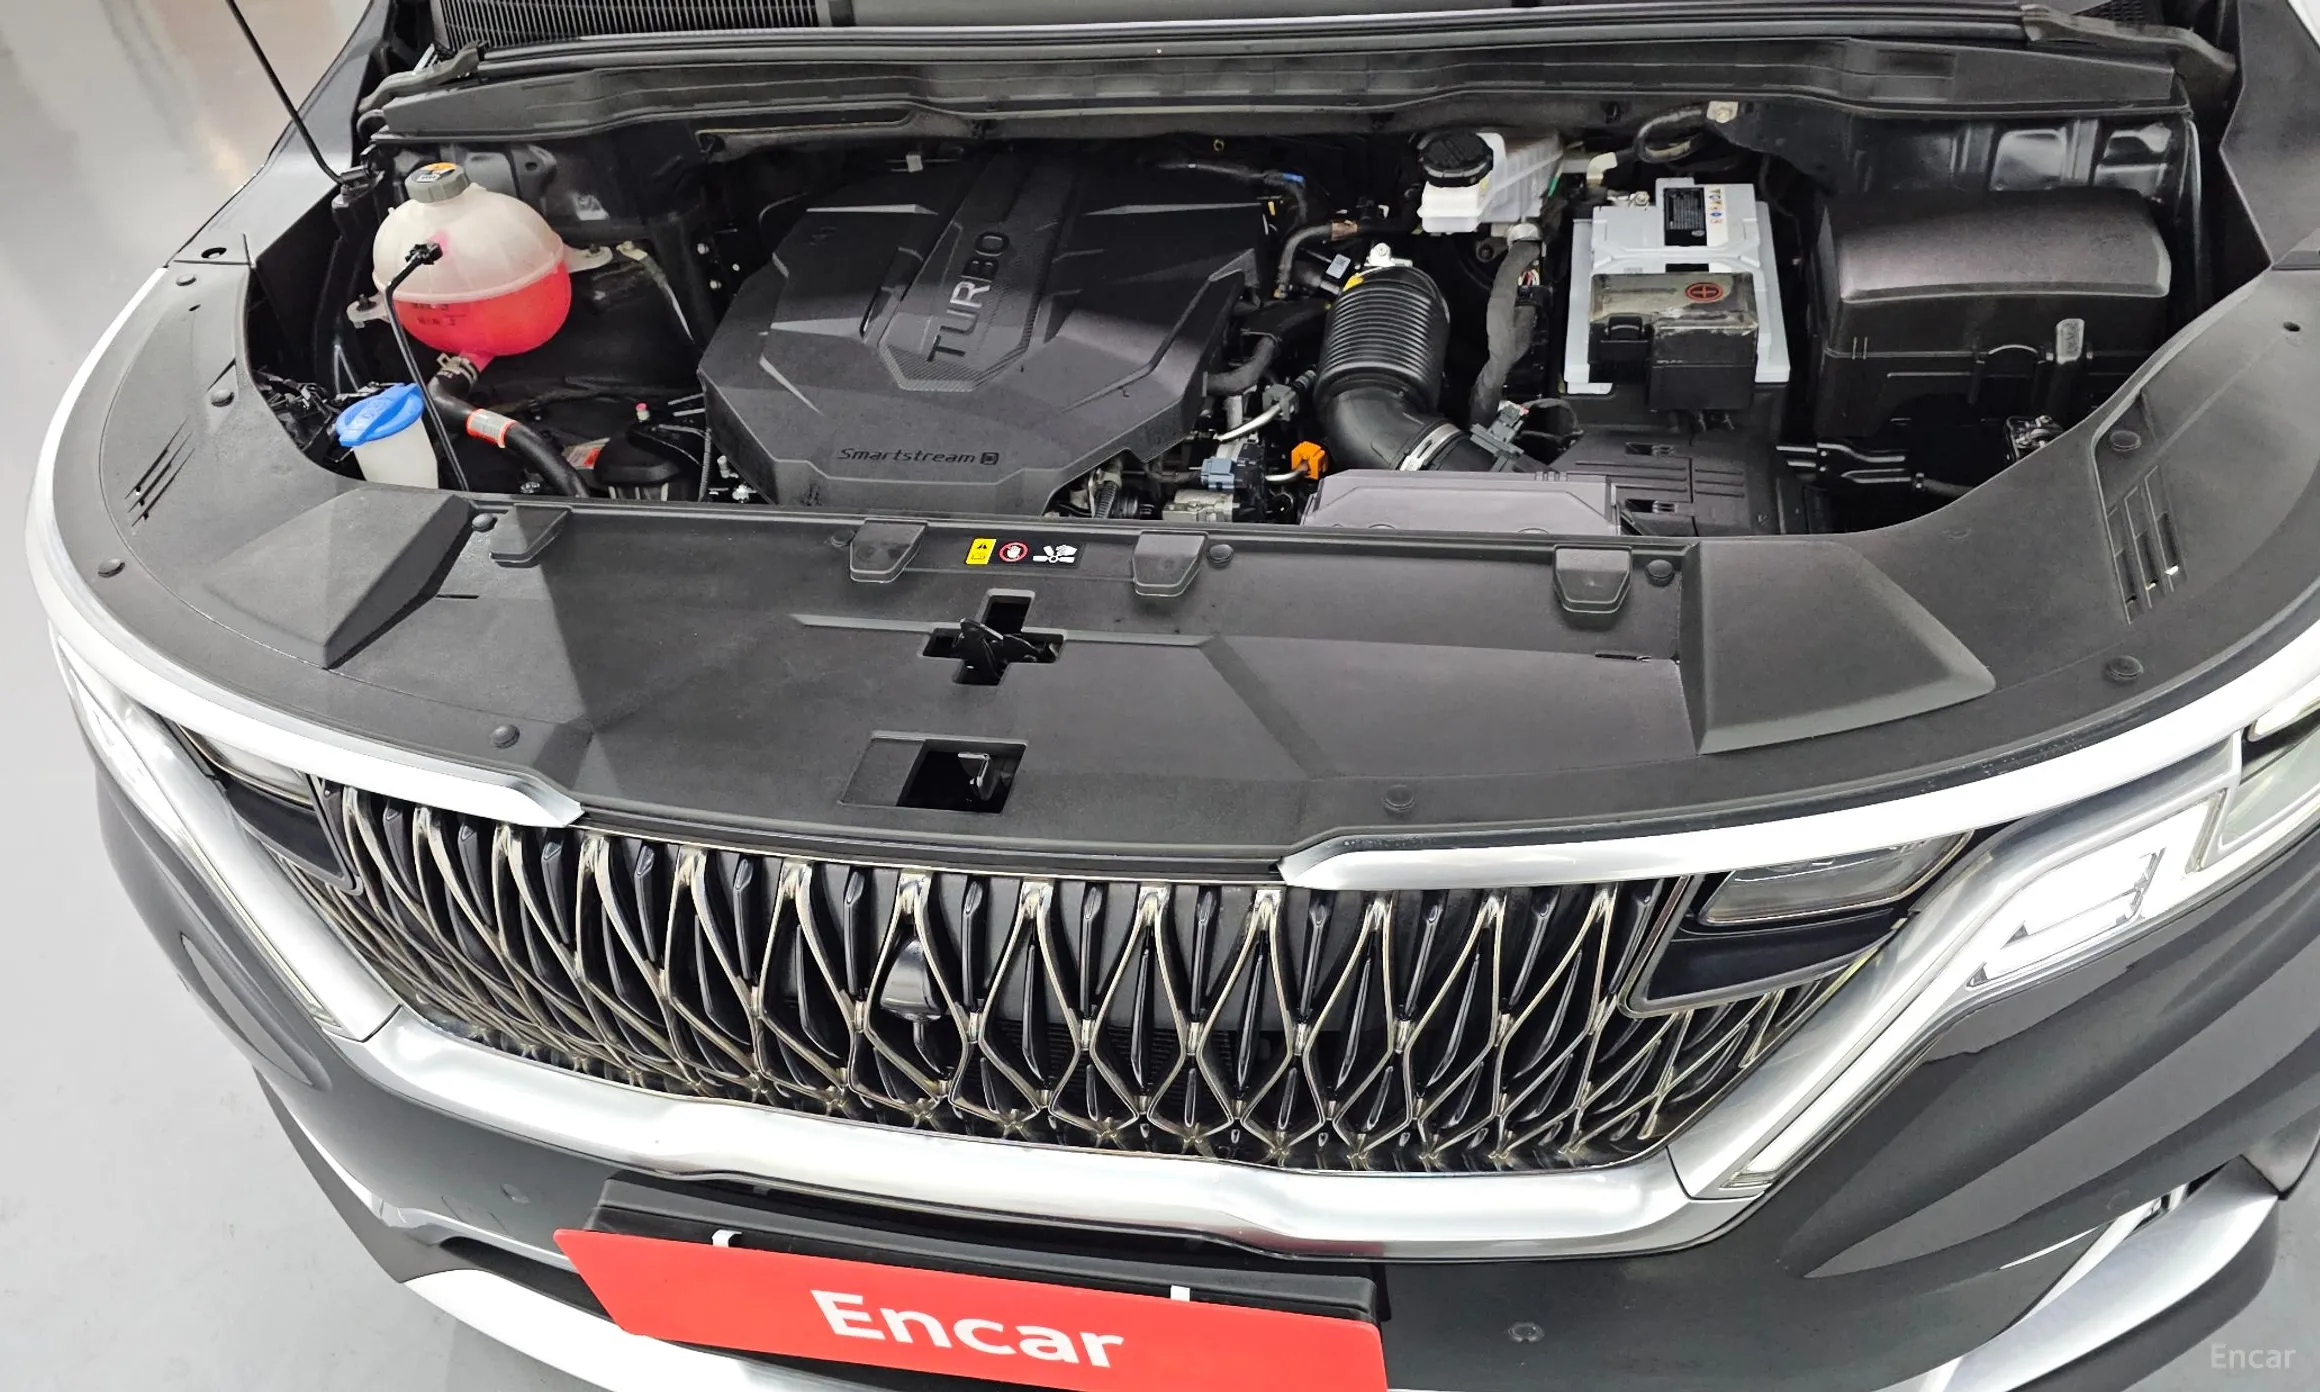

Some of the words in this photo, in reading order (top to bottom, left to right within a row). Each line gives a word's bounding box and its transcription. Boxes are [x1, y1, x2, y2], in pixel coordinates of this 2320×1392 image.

[927, 231, 1010, 362] TURBO
[836, 448, 976, 464] Smartstream
[810, 1289, 1125, 1368] Encar
